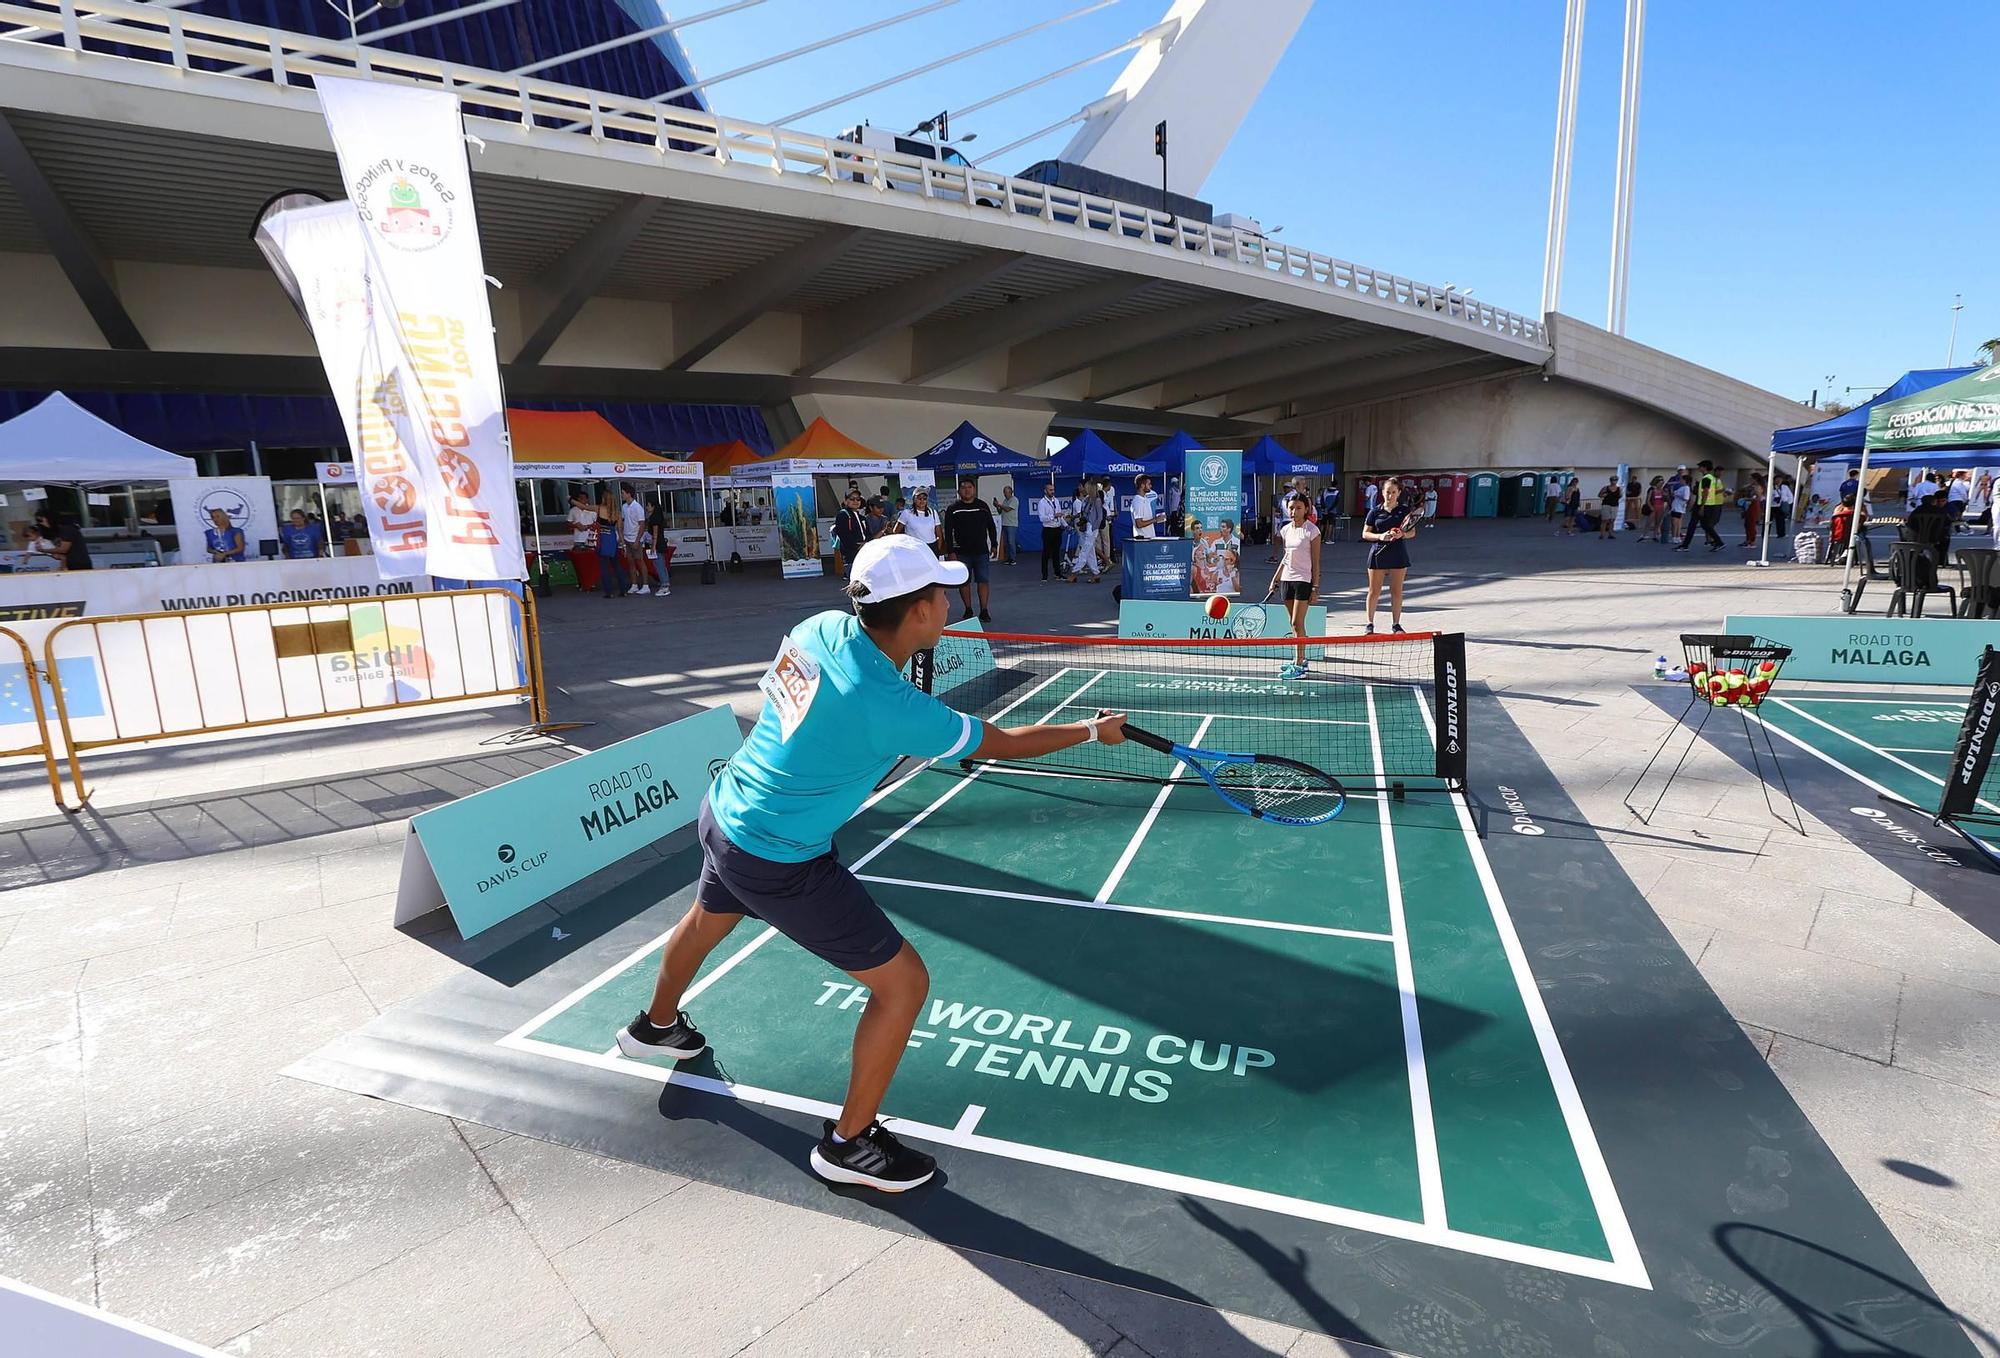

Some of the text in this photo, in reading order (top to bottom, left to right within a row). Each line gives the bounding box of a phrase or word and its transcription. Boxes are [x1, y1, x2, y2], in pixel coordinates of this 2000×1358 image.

[1906, 423, 1953, 437] COMUNIDAD
[160, 581, 414, 611] WWWPLOGGINGTOURCOM
[1190, 627, 1240, 639] MALA
[1849, 634, 1914, 646] ROAD TO
[1831, 648, 1931, 667] MALAGA
[1446, 661, 1458, 740] DUNLOP
[1962, 698, 1997, 785] DUNLOP
[588, 762, 653, 801] ROAD TO
[1498, 785, 1520, 801] CUP
[579, 779, 680, 841] MALAGA
[1870, 818, 1962, 867] DAVIS CUP
[476, 852, 548, 894] DAVIS CUP
[813, 981, 1276, 1077] TH WORLD CUP
[907, 1030, 1174, 1104] F TENNIS
